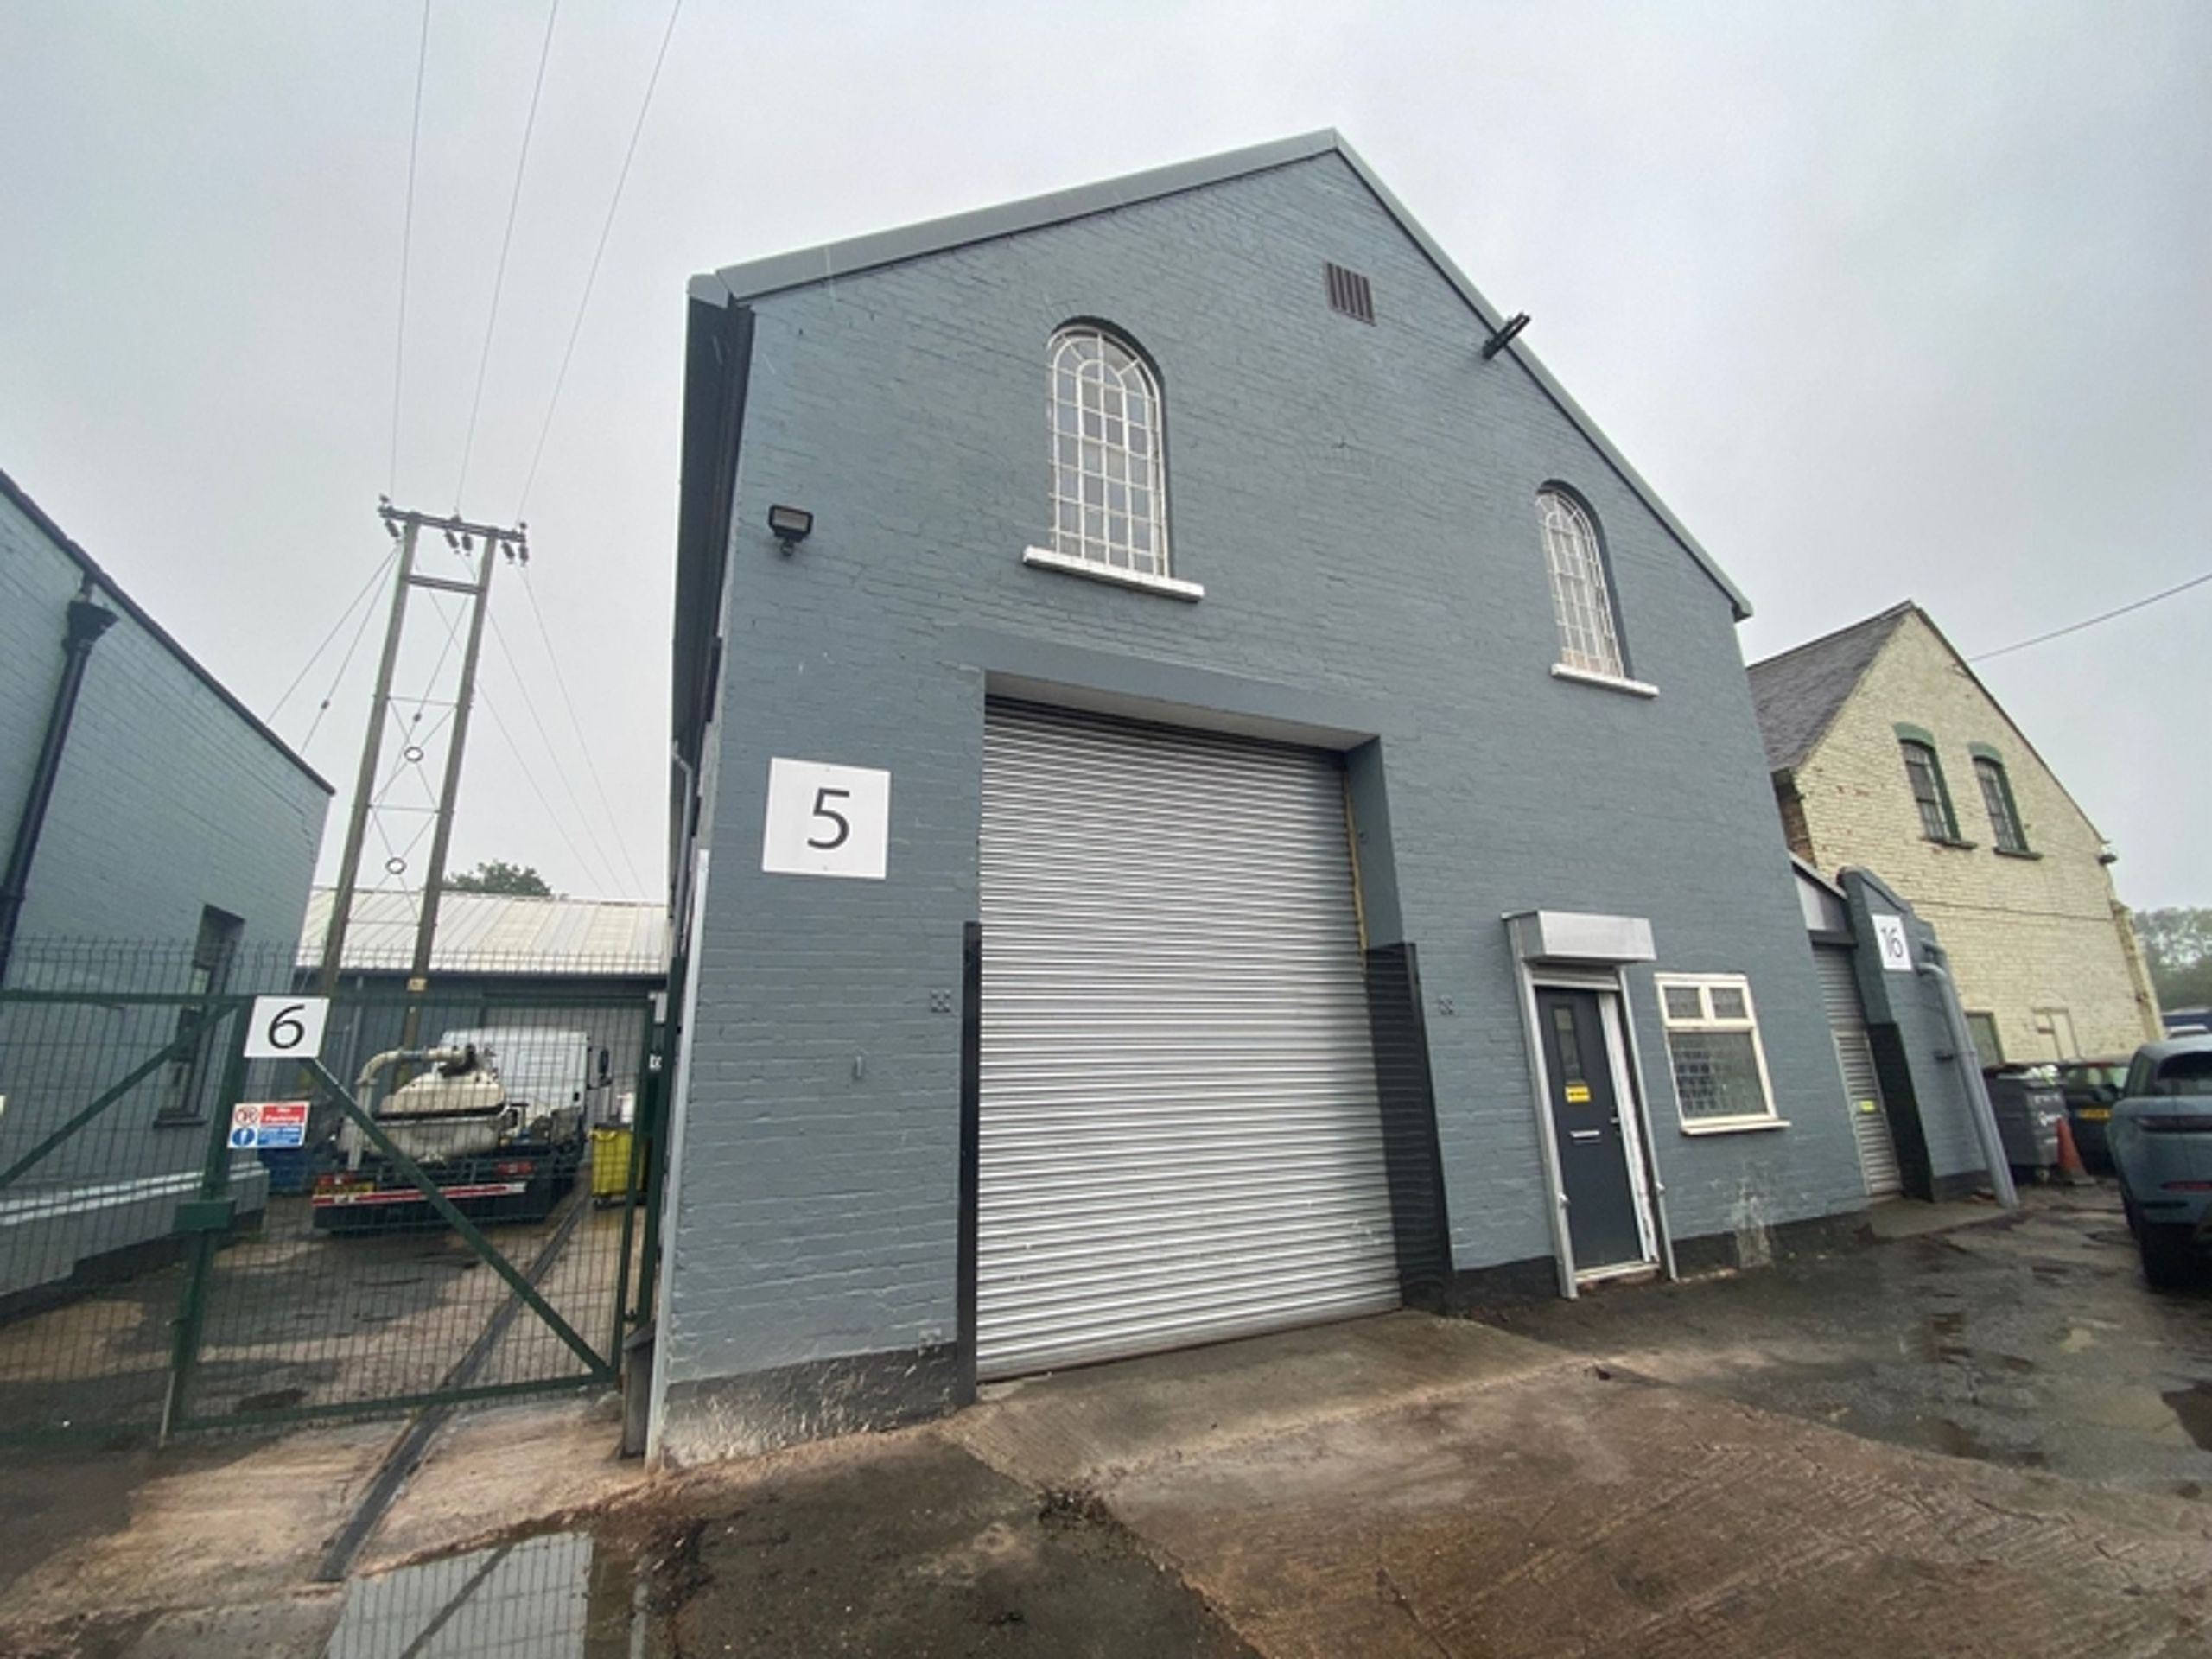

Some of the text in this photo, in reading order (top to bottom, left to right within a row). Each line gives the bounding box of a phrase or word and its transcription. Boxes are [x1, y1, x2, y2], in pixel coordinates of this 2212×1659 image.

[807, 787, 850, 849] 5
[1880, 926, 1904, 958] 16
[268, 1004, 304, 1050] 6
